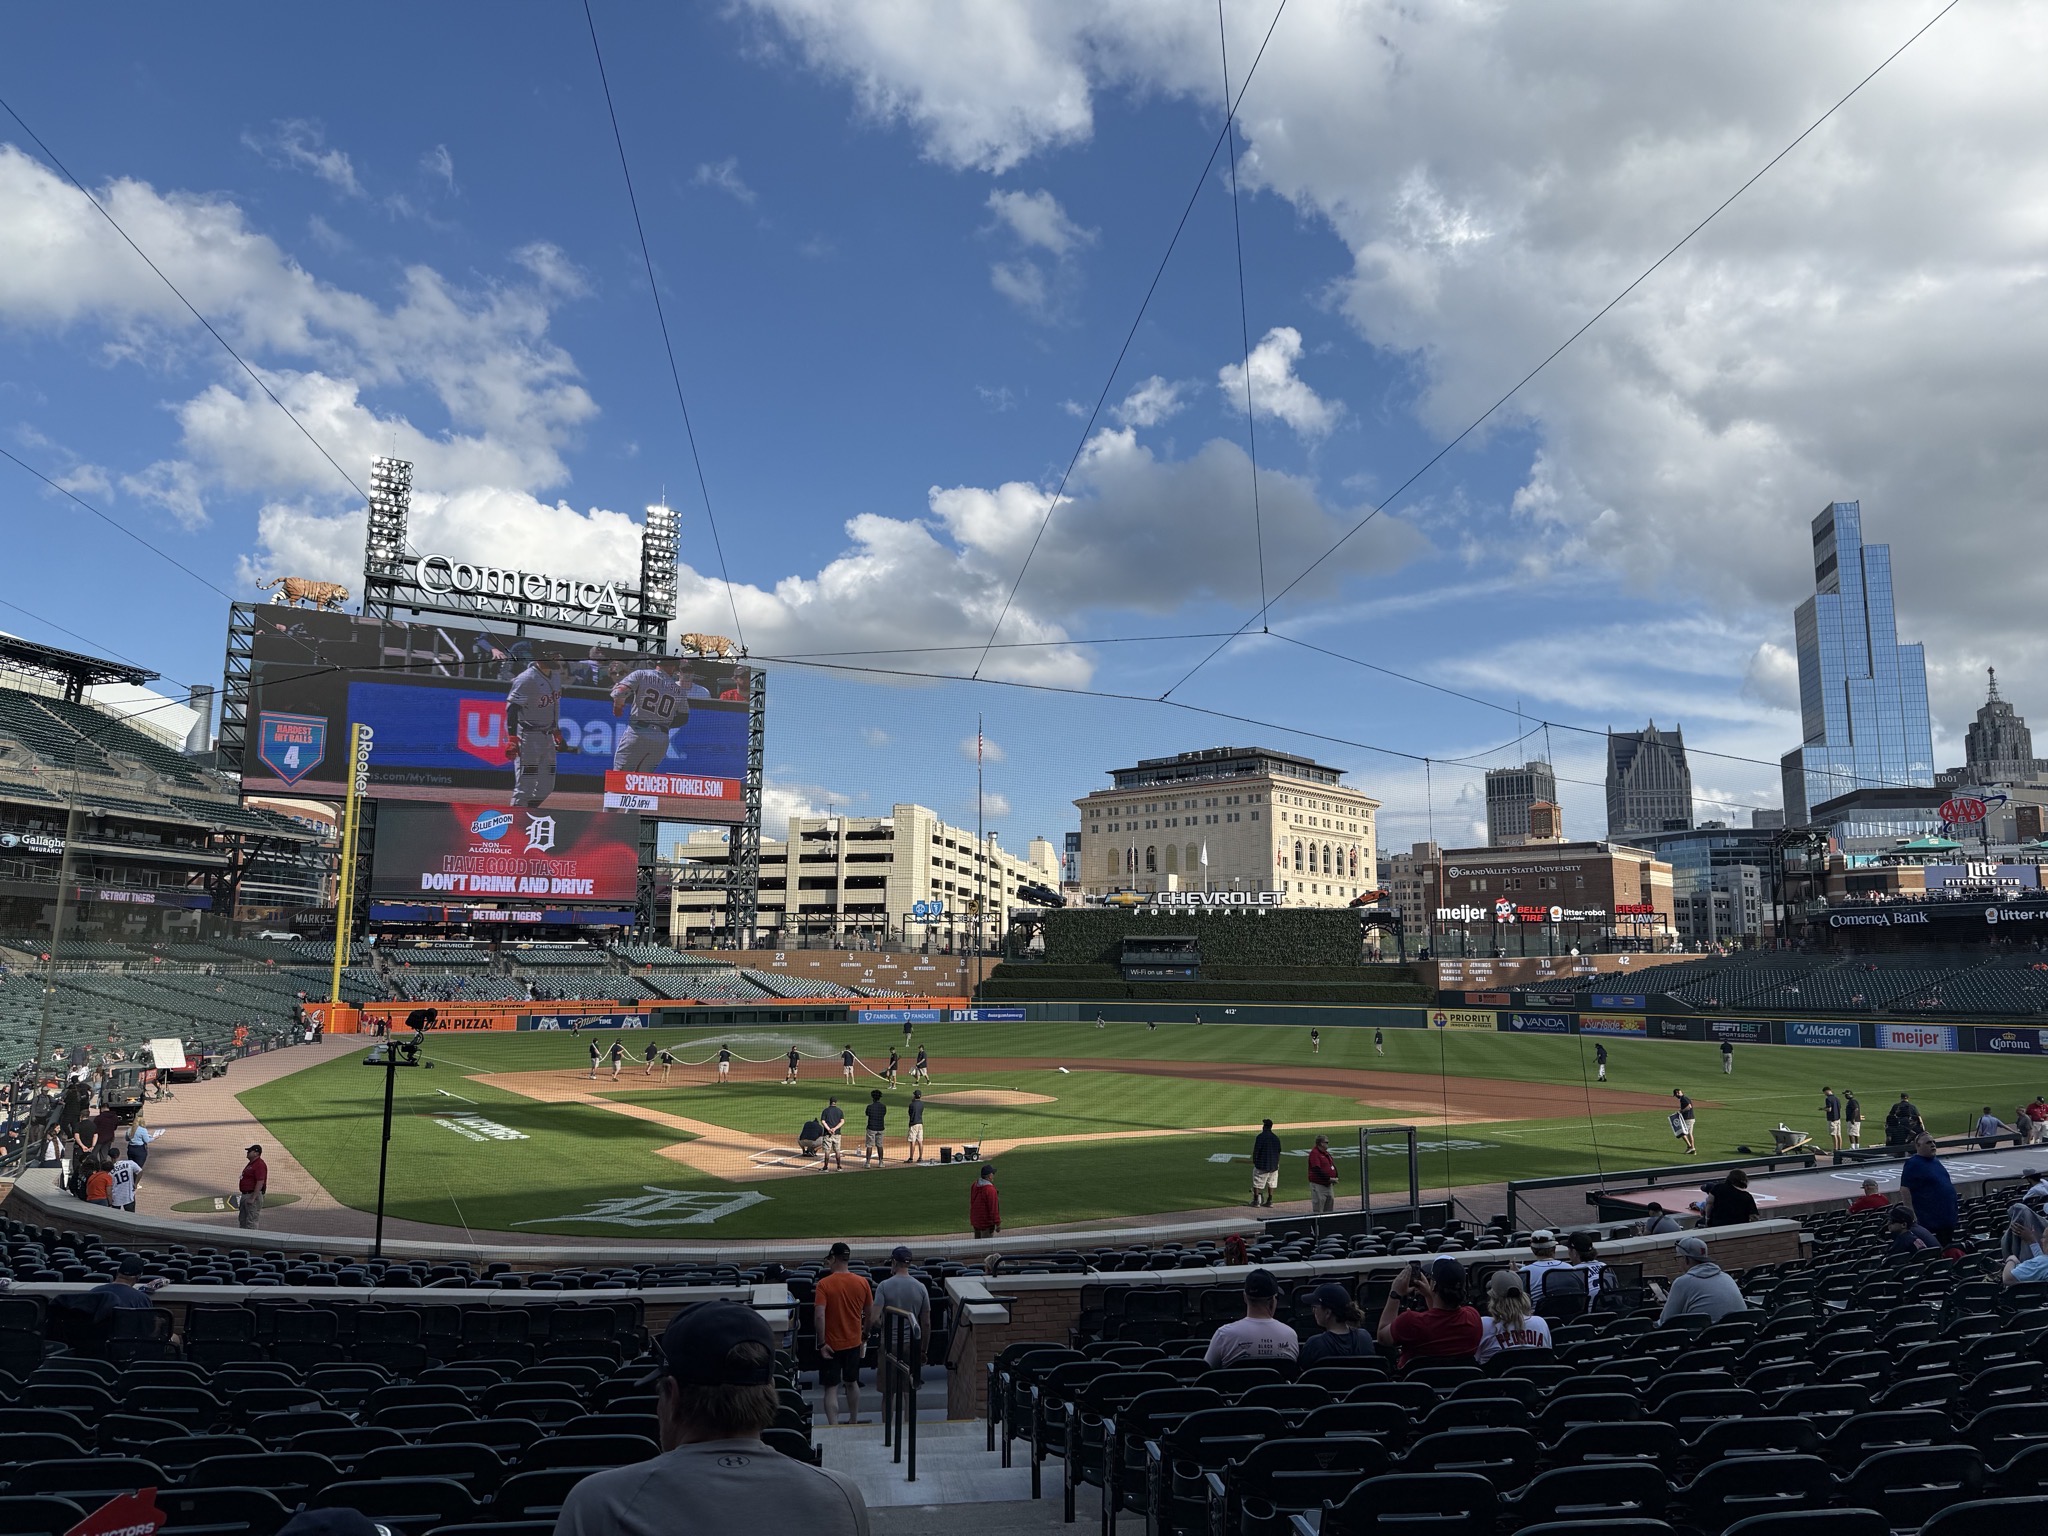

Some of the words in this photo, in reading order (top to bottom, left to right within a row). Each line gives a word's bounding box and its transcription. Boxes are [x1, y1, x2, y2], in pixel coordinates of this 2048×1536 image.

[476, 595, 572, 622] PARK
[641, 687, 676, 719] 20
[277, 724, 312, 735] HARDEST
[274, 733, 288, 742] HIT
[289, 734, 313, 744] BALLS
[283, 746, 300, 769] 4
[354, 742, 374, 798] Rocket
[1936, 775, 1957, 783] 1001
[625, 774, 668, 793] SPENCER
[670, 778, 723, 798] TORKELSON
[620, 795, 636, 807] 110.5
[637, 800, 650, 808] MPH
[1944, 798, 1984, 822] AAA
[471, 820, 492, 832] BLUE
[493, 815, 513, 825] MOON
[21, 834, 66, 848] Gallaghe
[28, 846, 62, 855] INSURANCE
[442, 855, 484, 874] HAVE
[485, 857, 528, 875] GOOD
[529, 859, 577, 876] TASTE
[1460, 868, 1485, 876] GRAND
[1485, 867, 1512, 875] VALLEY
[1512, 866, 1534, 874] STATE
[1534, 865, 1582, 873] UNIVERSITY
[1968, 862, 1997, 879] Lite
[421, 873, 468, 890] DON'T
[469, 874, 516, 893] DRINK
[518, 876, 549, 894] AND
[550, 878, 594, 895] DRIVE
[100, 890, 130, 901] DETROIT
[131, 892, 156, 903] TIGERS
[1157, 892, 1286, 906] CHEVROLET
[472, 910, 511, 920] DETROIT
[511, 911, 542, 921] TIGERS
[1134, 908, 1266, 916] FOUNTAIN
[1436, 904, 1487, 923] meijer
[1517, 906, 1547, 914] BELLE
[295, 913, 333, 924] MARKET
[1521, 914, 1544, 922] TIRE
[1630, 914, 1654, 923] LAW
[1893, 911, 1930, 924] Bank
[1540, 959, 1551, 968] 10
[1580, 957, 1589, 965] 11
[1618, 956, 1630, 965] 42
[864, 969, 873, 977] 47
[944, 972, 948, 980] 1
[953, 1010, 979, 1021] DTE
[1450, 1014, 1491, 1022] PRIORITY
[454, 1018, 493, 1030] PIZZA!
[1524, 1017, 1566, 1028] VANDA
[1584, 1018, 1620, 1031] Surfside
[1712, 1022, 1740, 1031] ESPN
[1741, 1023, 1763, 1033] BET
[1808, 1025, 1851, 1037] McLaren
[1892, 1029, 1940, 1047] meijer
[1989, 1037, 2031, 1051] Corona
[114, 1169, 130, 1185] 18
